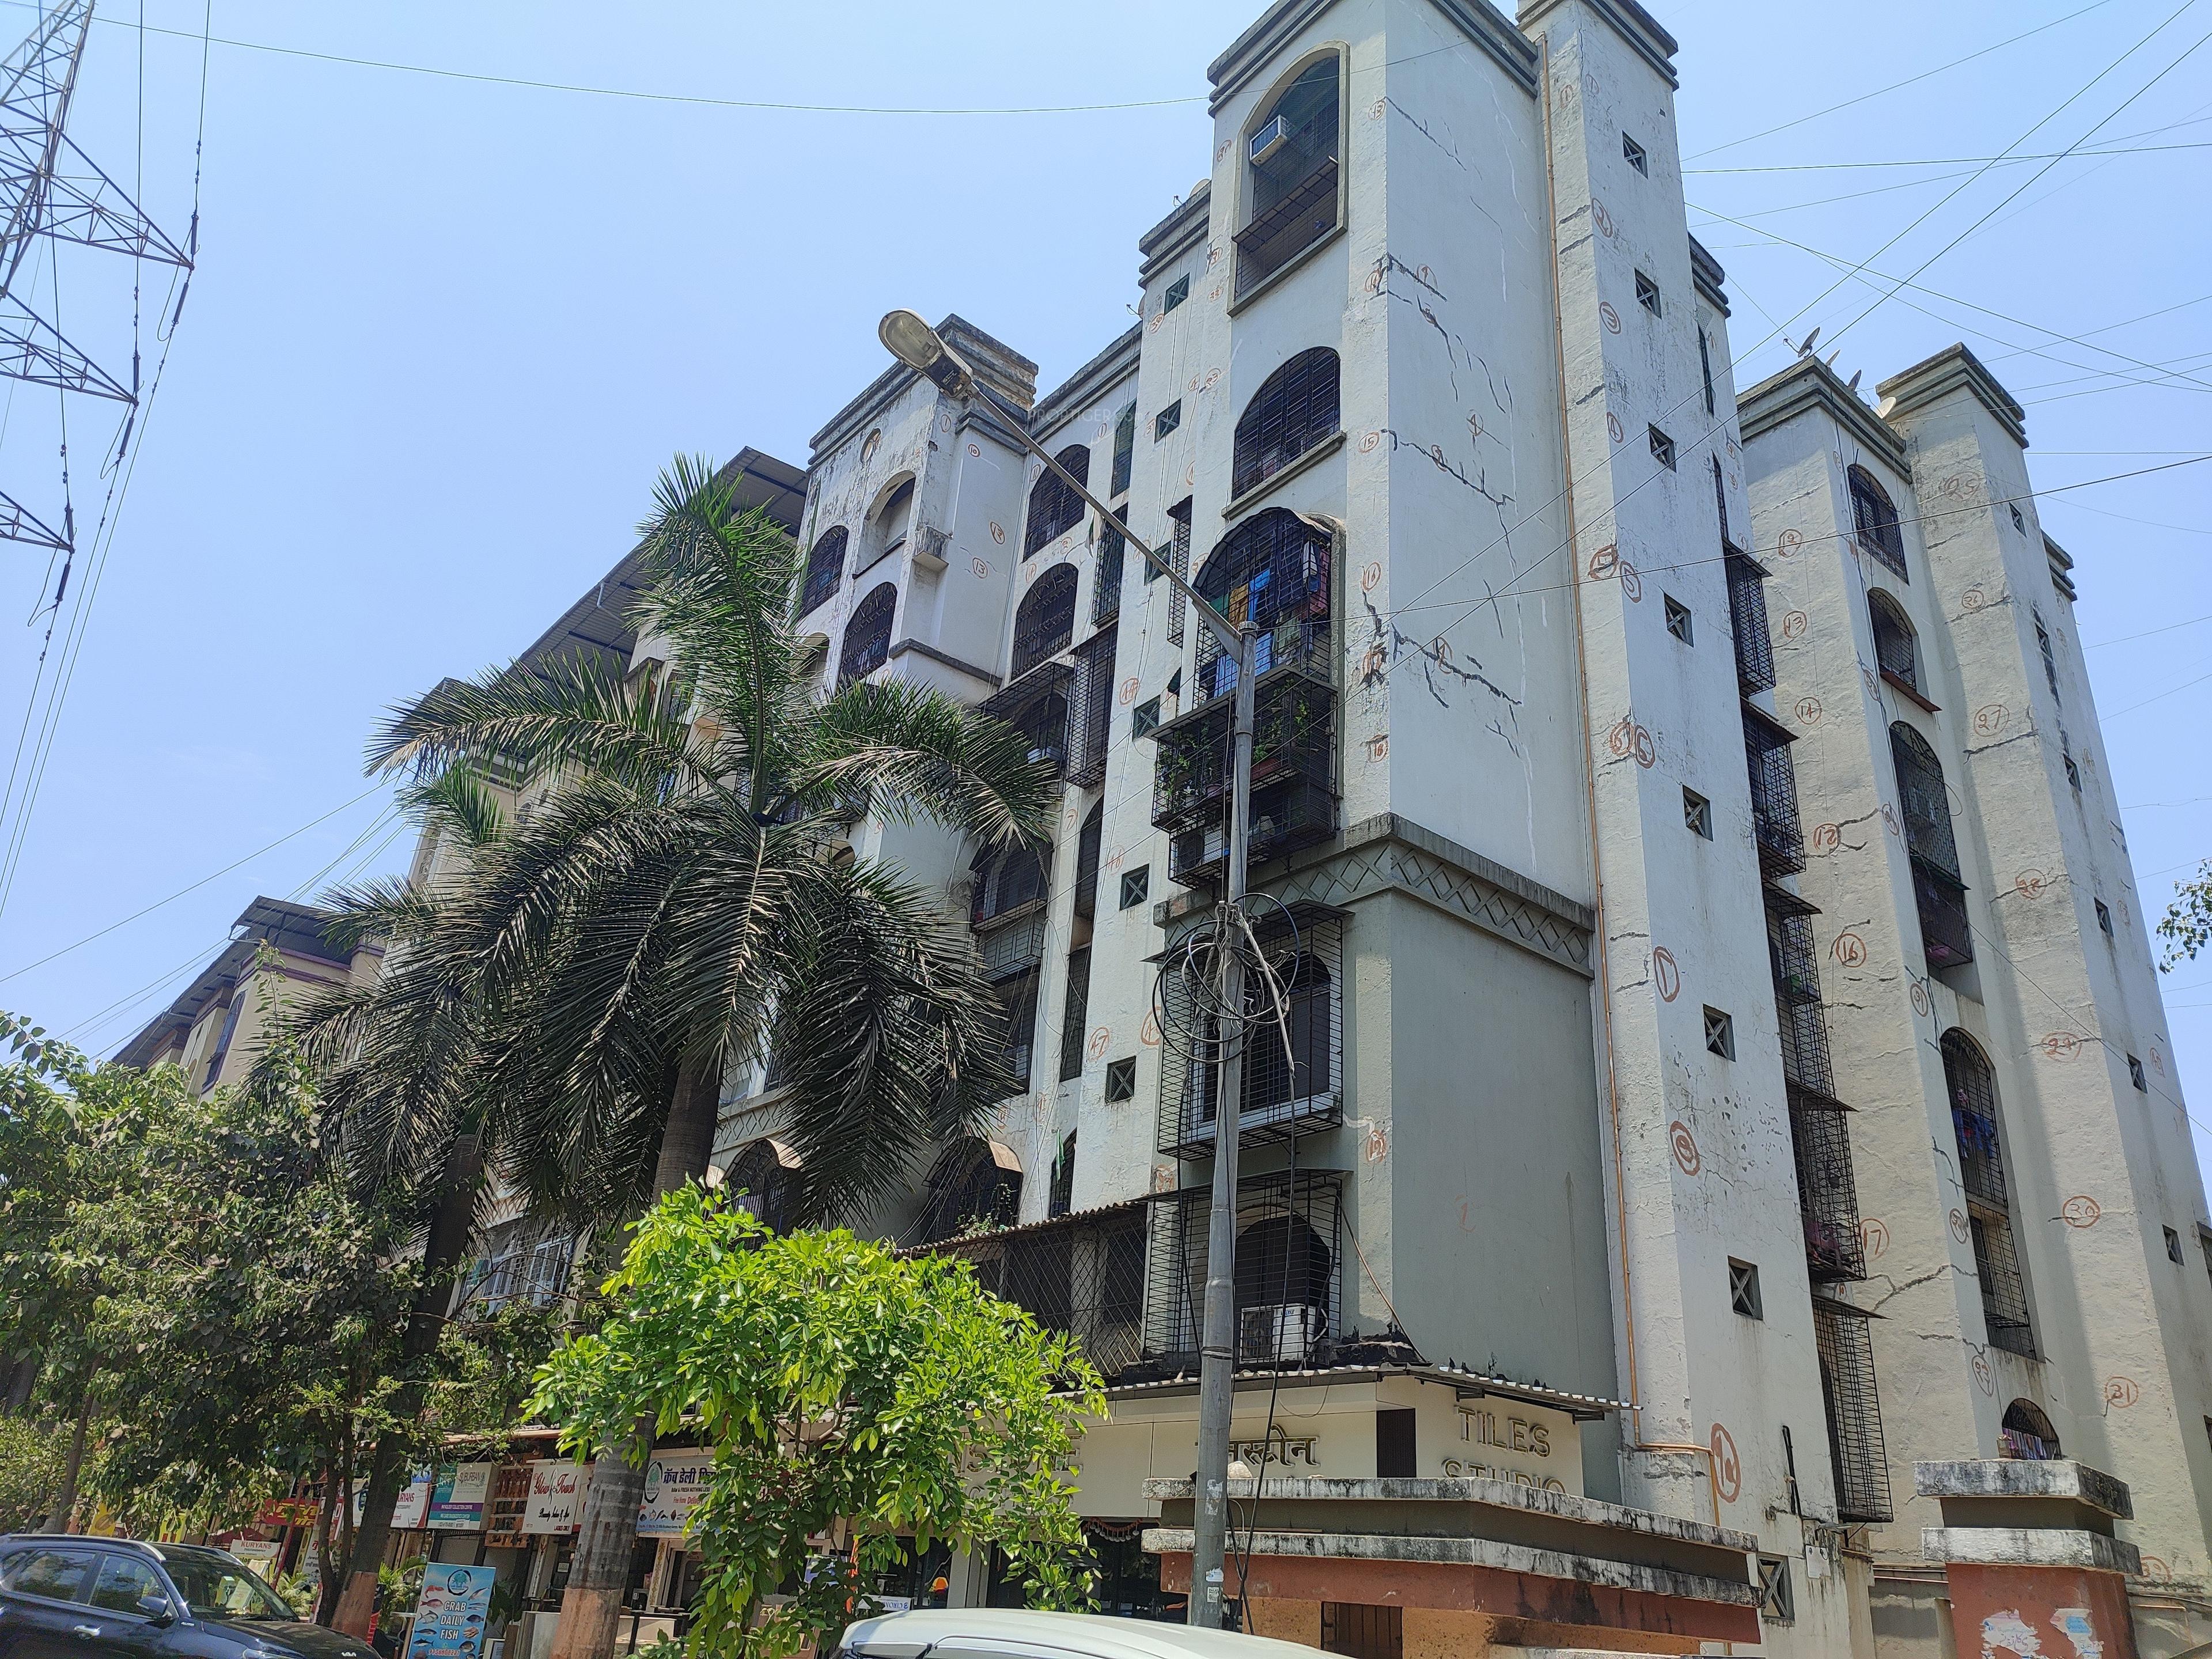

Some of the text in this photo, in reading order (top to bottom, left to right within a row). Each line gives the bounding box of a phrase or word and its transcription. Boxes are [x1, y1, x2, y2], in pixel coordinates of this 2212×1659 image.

[1456, 1406, 1551, 1458] TILES
[556, 1473, 578, 1494] Touch
[397, 1493, 415, 1502] URYANS
[240, 1541, 272, 1550] KURYANS
[443, 1600, 467, 1612] CRAB
[440, 1615, 465, 1626] DAILY
[440, 1629, 459, 1640] FISH
